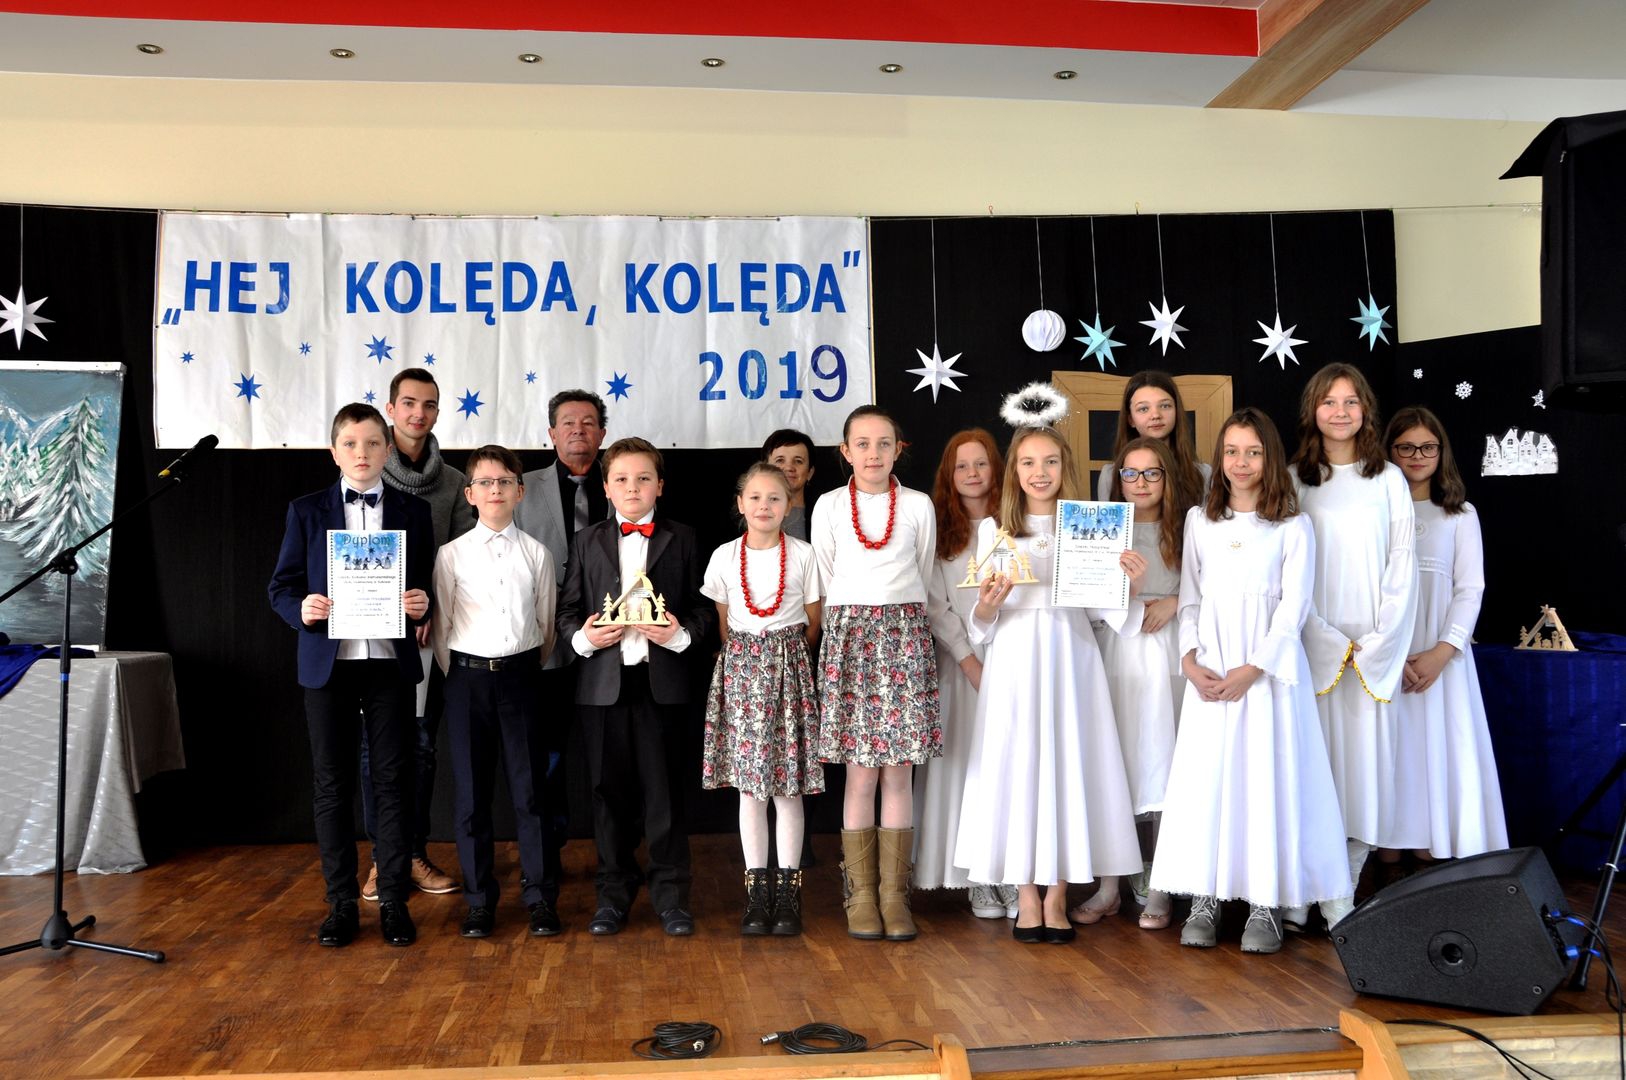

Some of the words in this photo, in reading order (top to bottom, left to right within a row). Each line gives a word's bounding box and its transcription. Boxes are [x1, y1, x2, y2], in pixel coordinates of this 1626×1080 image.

[346, 260, 597, 326] KOLĘDA,
[699, 345, 848, 403] 2019
[1072, 504, 1119, 518] Dyplom
[342, 533, 392, 548] Dyplom
